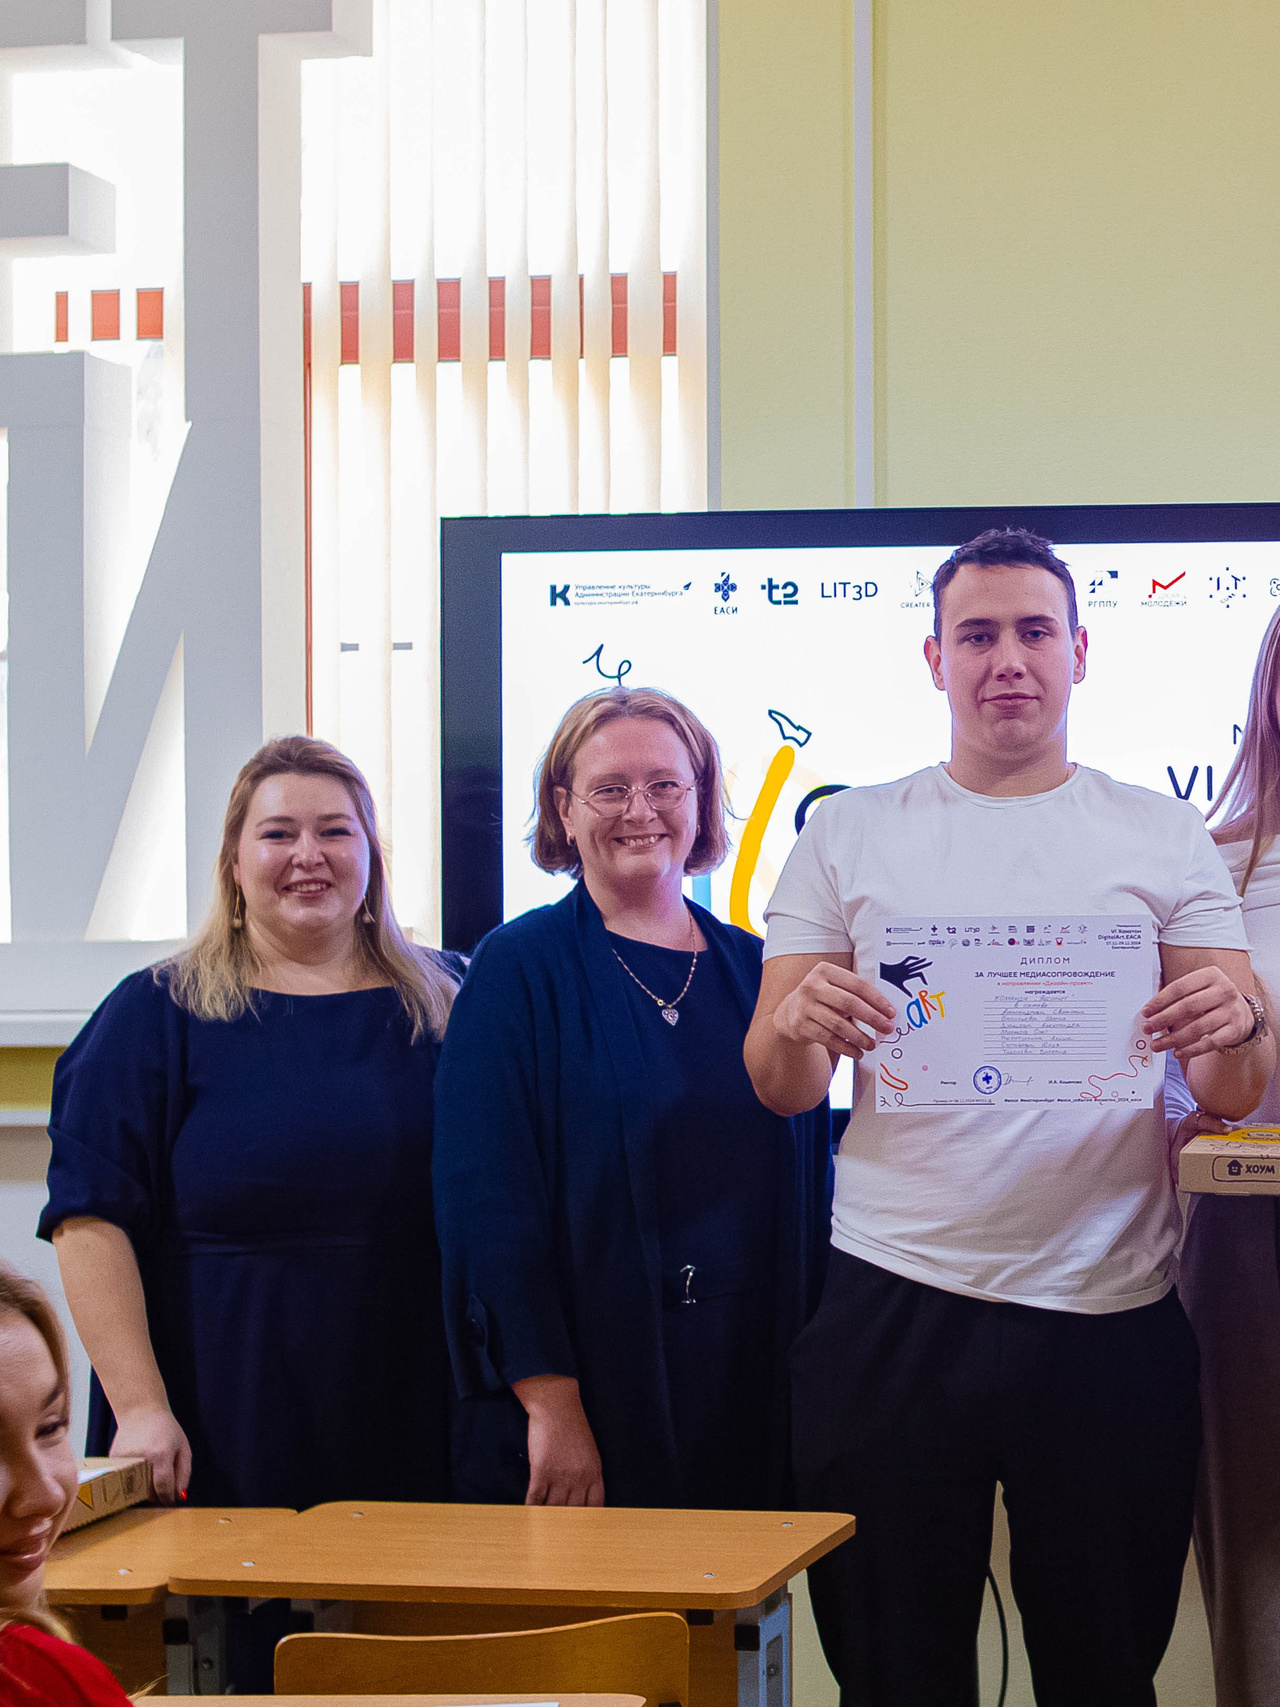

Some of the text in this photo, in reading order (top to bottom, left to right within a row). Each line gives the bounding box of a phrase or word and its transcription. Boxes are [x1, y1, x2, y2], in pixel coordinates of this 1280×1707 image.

[631, 590, 684, 598] Екатеринбурга
[820, 581, 878, 600] LIT3D
[1088, 600, 1118, 608] РГППУ
[714, 606, 738, 615] ЕАСИ
[1020, 957, 1070, 966] ДИПЛОМ
[1019, 971, 1116, 979] МЕДИАСОПРОВОЖДЕНИЕ
[1245, 1164, 1276, 1175] ХОУМ
